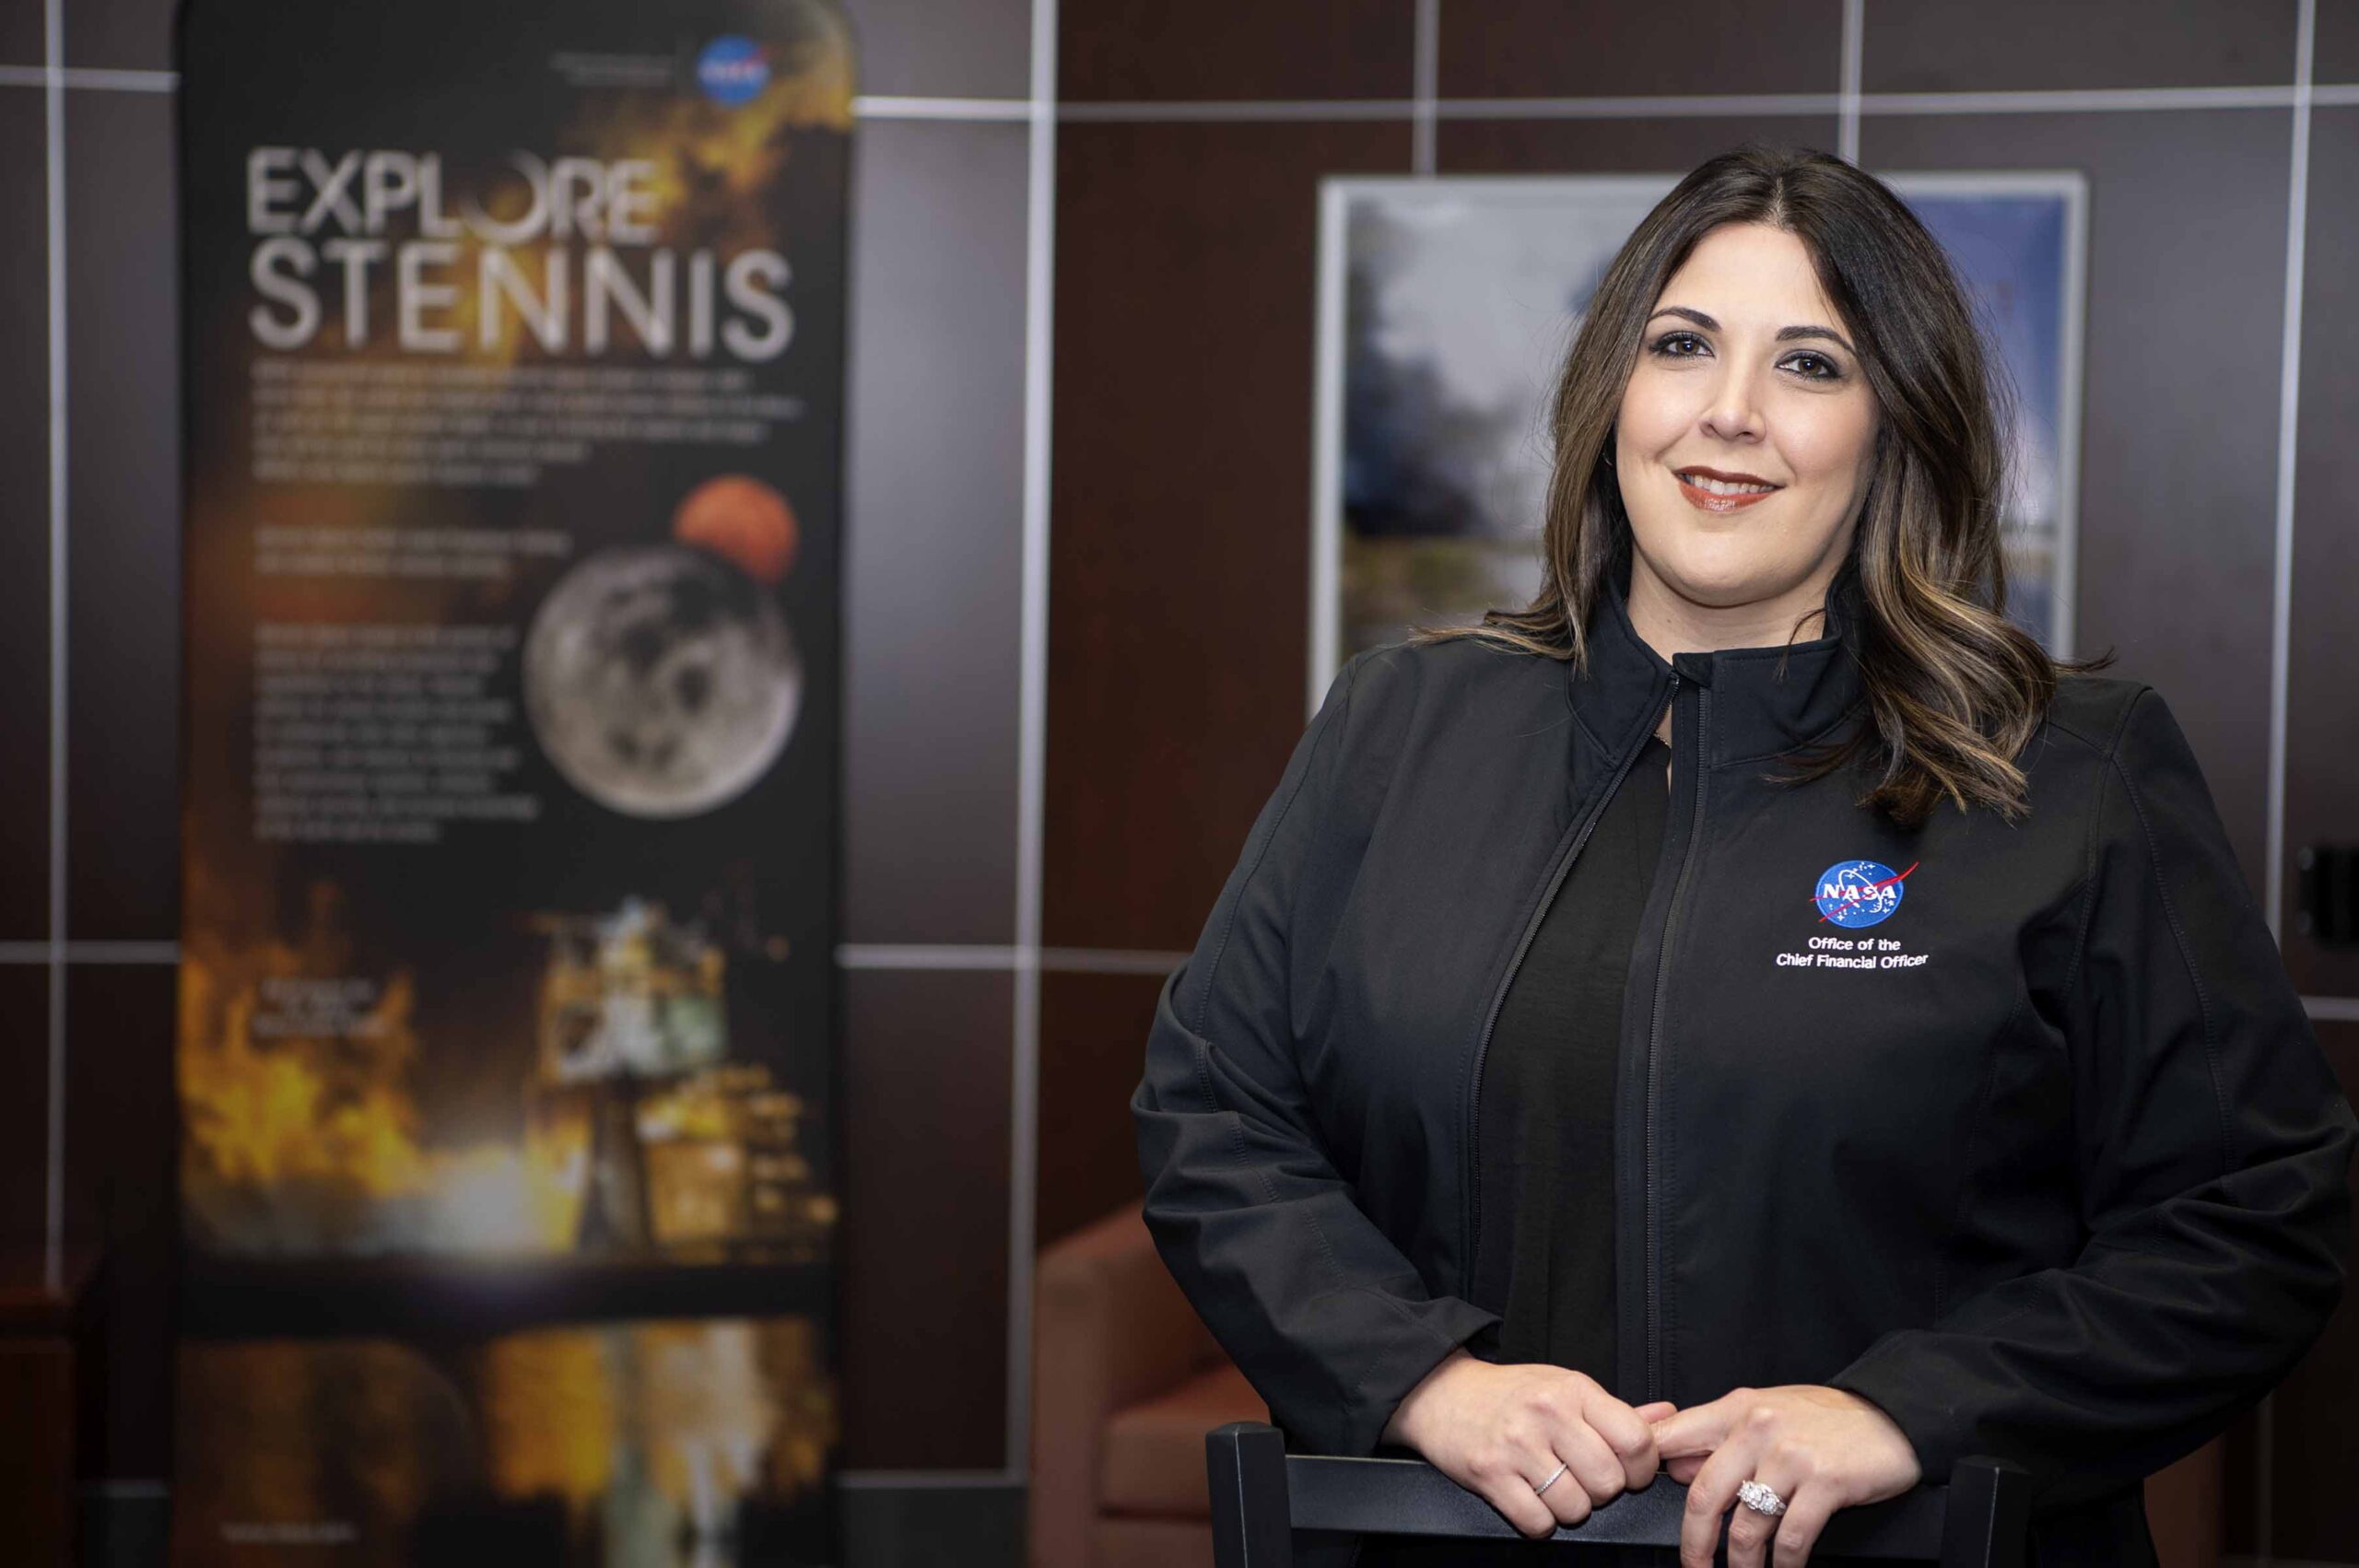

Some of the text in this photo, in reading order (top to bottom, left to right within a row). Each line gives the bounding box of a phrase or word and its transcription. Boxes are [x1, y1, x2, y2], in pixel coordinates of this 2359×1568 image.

[246, 147, 658, 243] EXPLORE
[249, 238, 794, 362] STENNIS
[1823, 883, 1896, 901] NASA
[1808, 937, 1901, 951] Office of the
[1776, 953, 1929, 969] Chief Financial Officer
